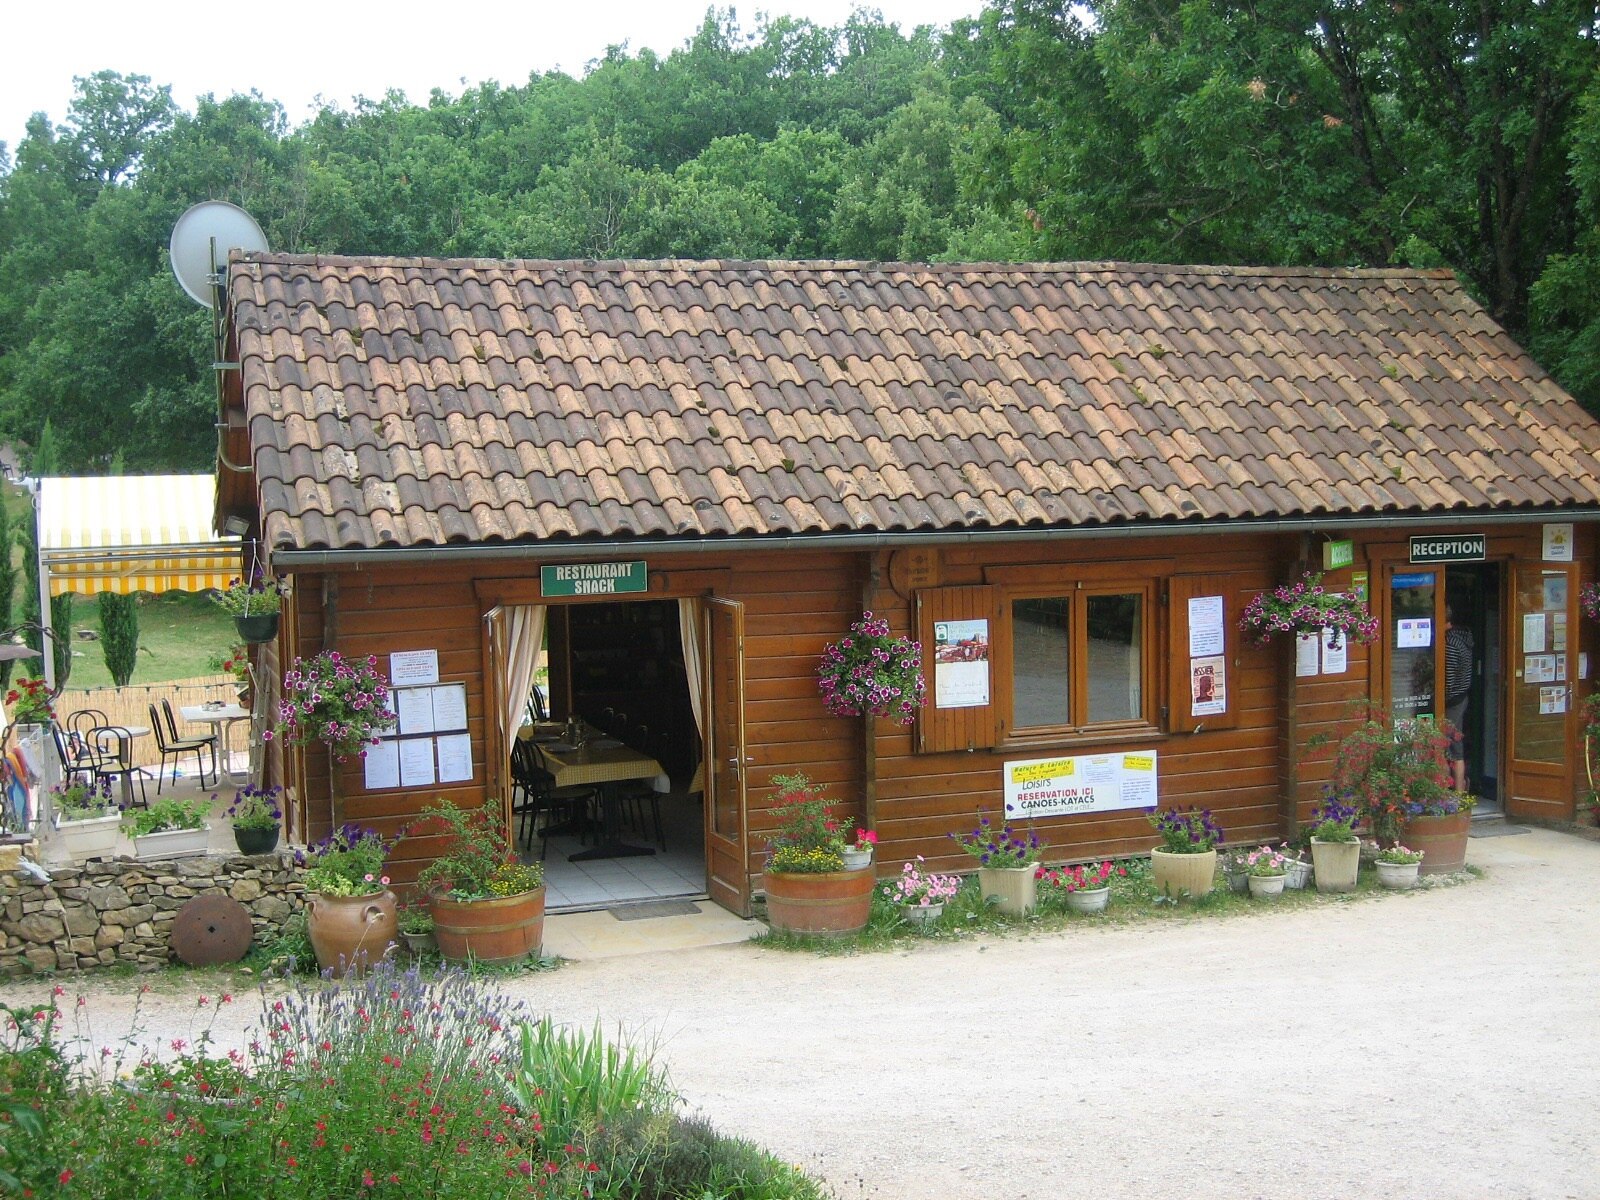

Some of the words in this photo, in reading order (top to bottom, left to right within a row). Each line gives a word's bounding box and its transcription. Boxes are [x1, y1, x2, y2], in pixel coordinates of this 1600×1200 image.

[1412, 541, 1483, 556] RECEPTION
[556, 563, 632, 580] RESTAURANT
[574, 578, 615, 594] SNACK
[1022, 778, 1052, 790] Loisirs
[1017, 788, 1078, 801] RESERVATION
[1082, 787, 1094, 795] ICI
[1020, 795, 1095, 809] CANOES-KAYACS
